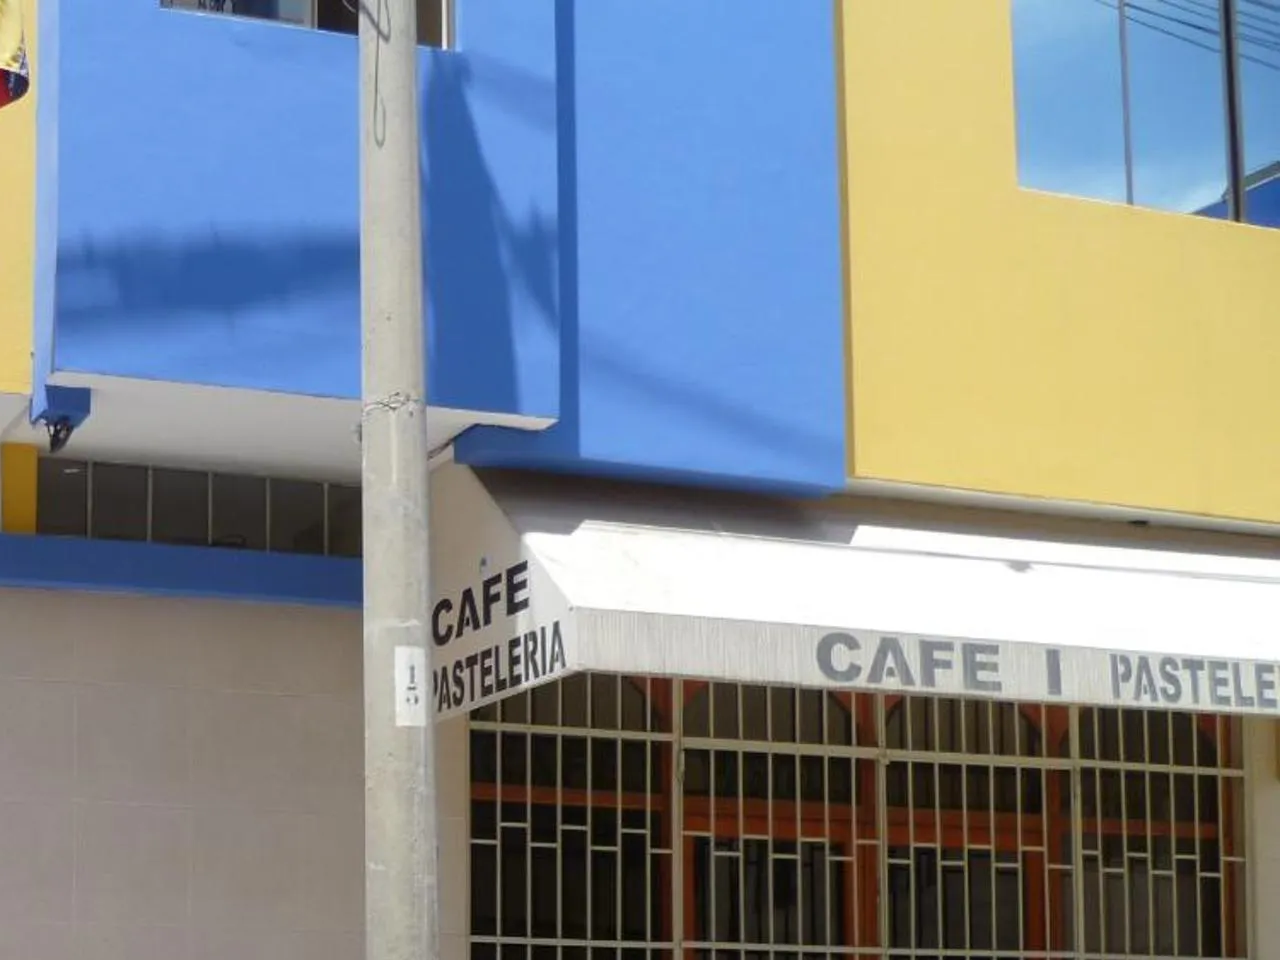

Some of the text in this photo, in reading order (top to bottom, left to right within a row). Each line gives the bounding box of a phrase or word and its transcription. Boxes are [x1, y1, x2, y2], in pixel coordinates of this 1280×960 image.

[432, 560, 529, 646] CAFE
[816, 632, 1002, 692] CAFE
[1109, 653, 1280, 709] PASTELE
